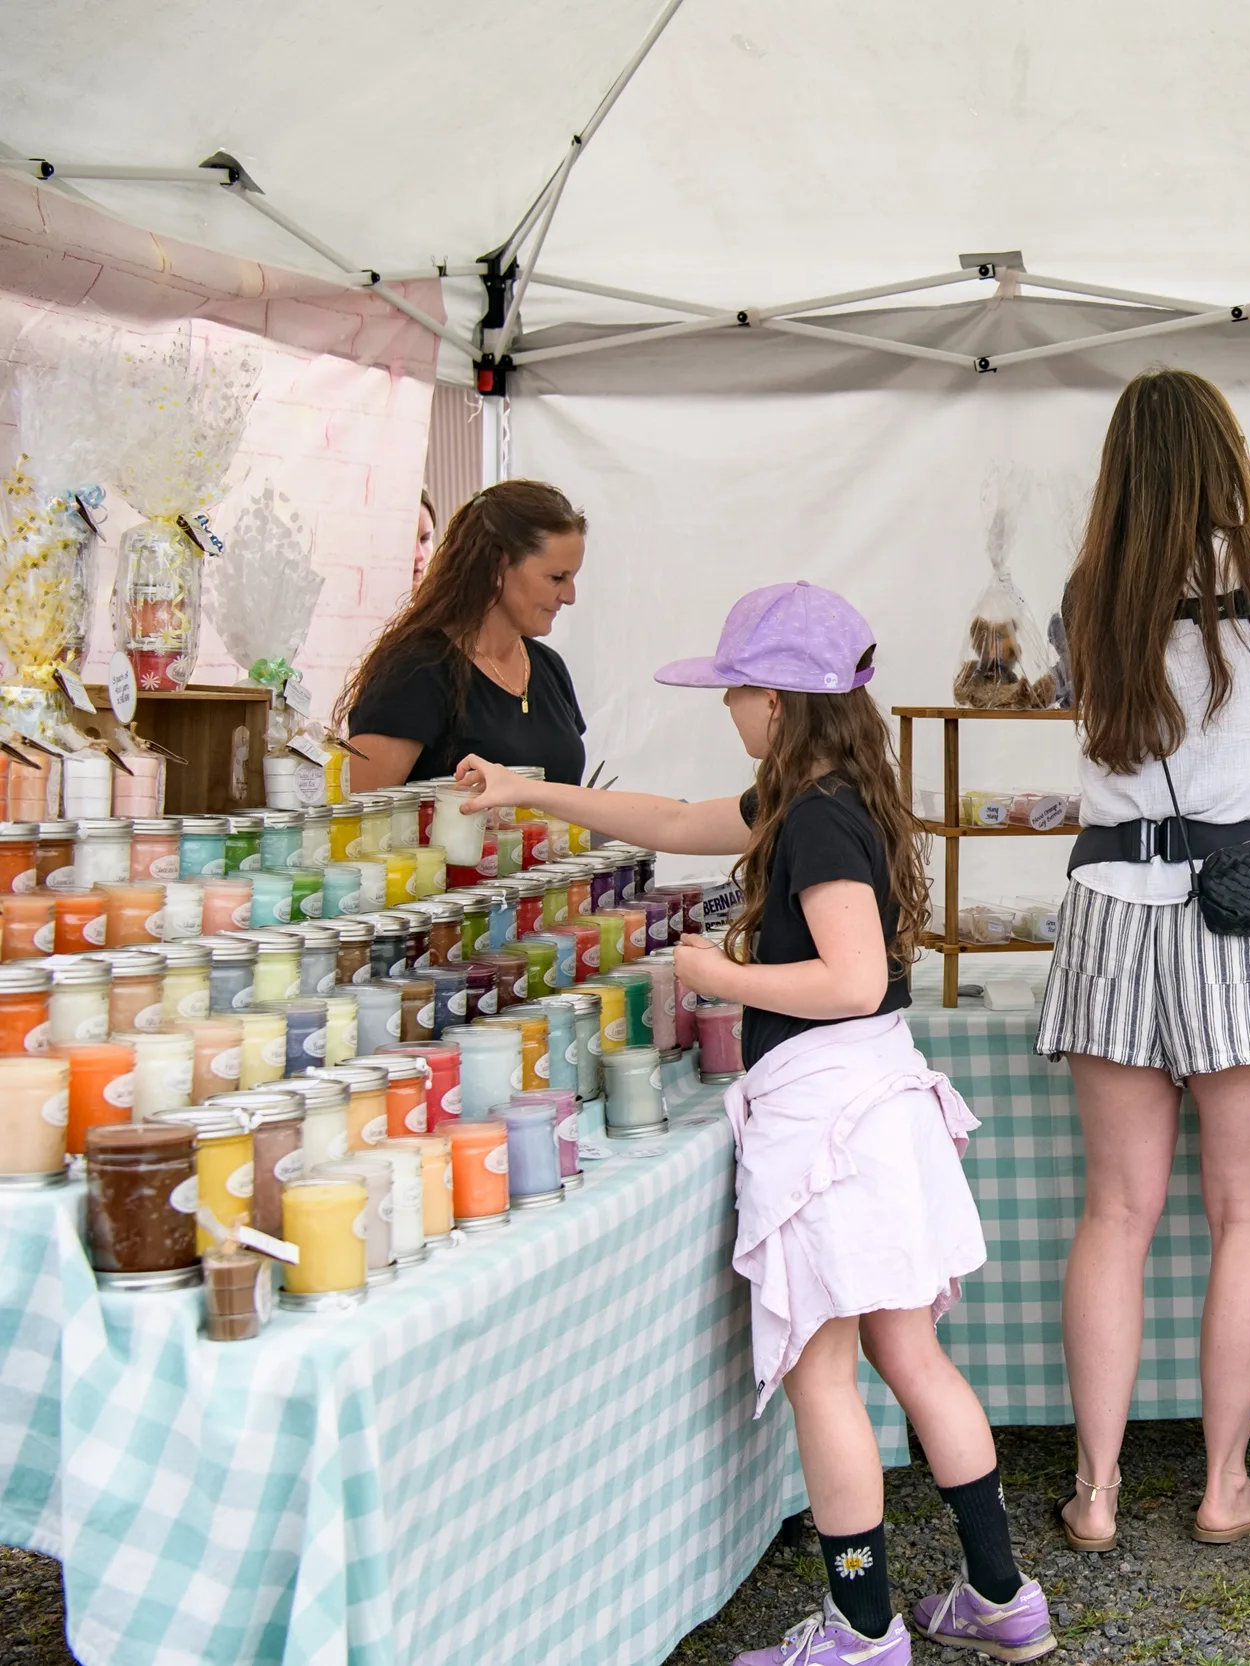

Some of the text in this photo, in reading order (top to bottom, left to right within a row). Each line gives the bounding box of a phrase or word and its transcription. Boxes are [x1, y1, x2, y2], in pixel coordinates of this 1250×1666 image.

[1032, 813, 1044, 825] Blood
[1044, 804, 1057, 816] Orange
[1046, 808, 1062, 822] Berries
[703, 890, 743, 916] BERNAR
